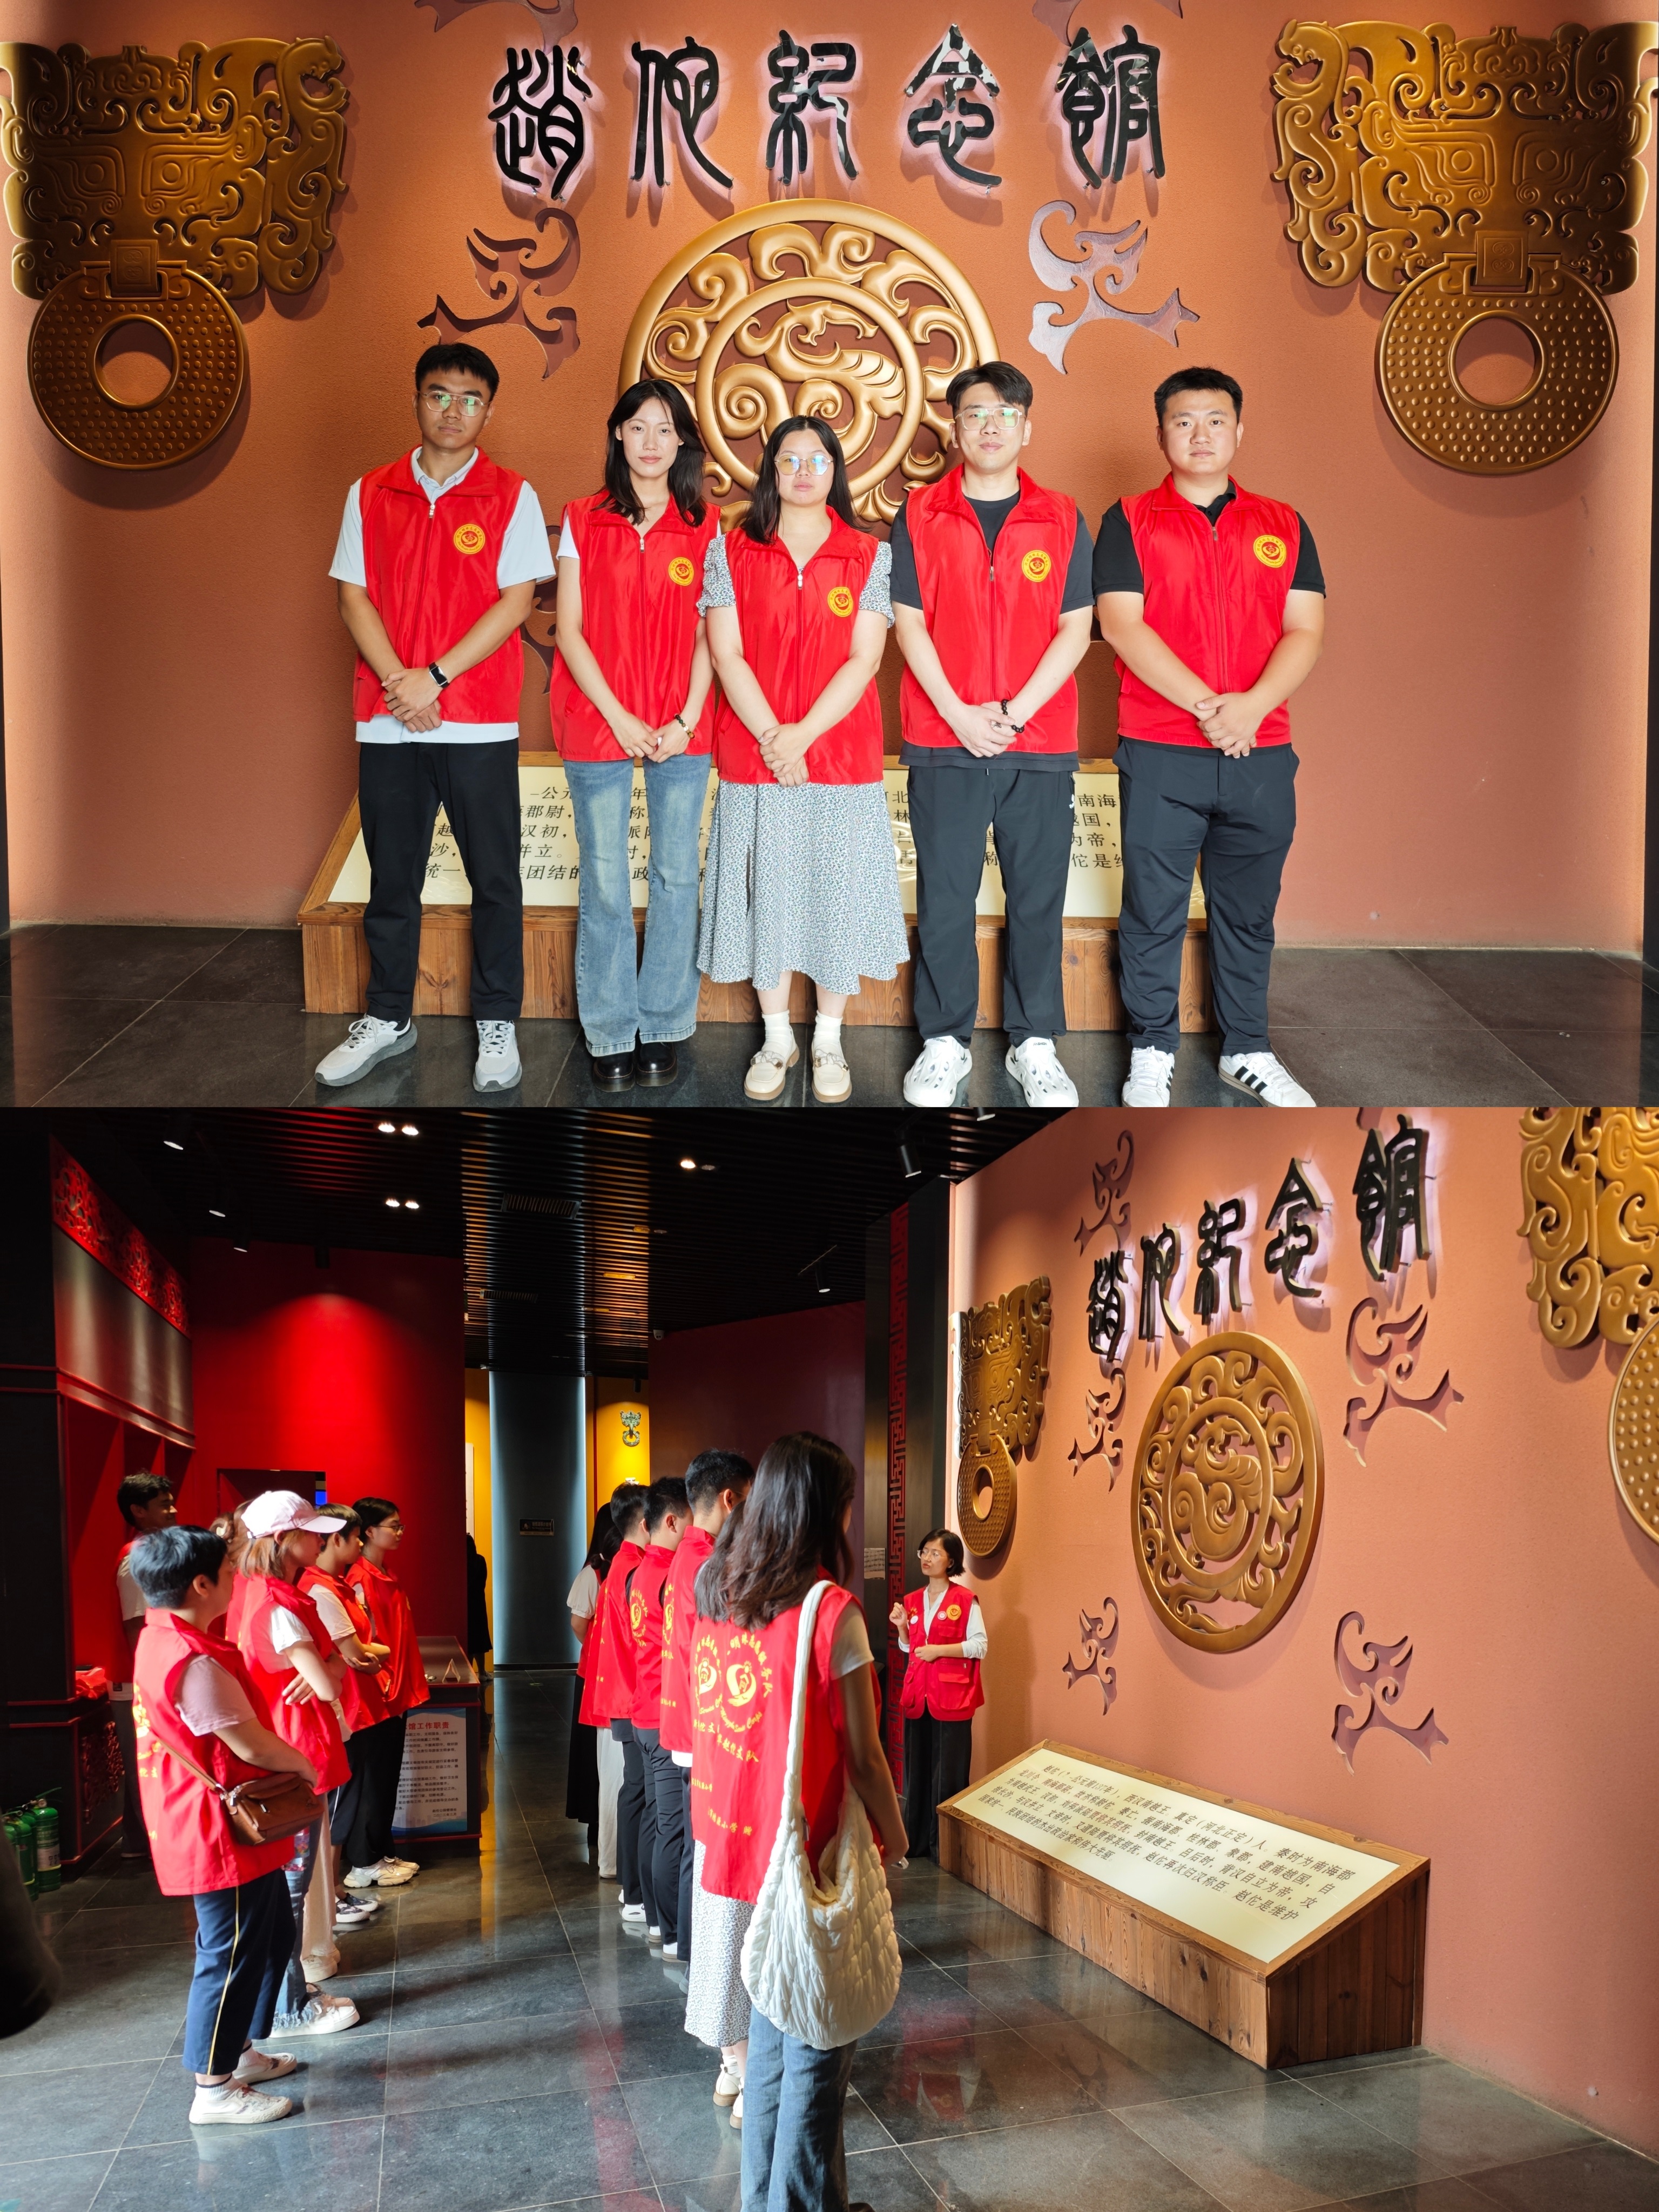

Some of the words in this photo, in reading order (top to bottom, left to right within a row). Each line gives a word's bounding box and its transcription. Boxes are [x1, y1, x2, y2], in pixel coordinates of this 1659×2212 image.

[406, 1722, 449, 1730] 馆工作职责
